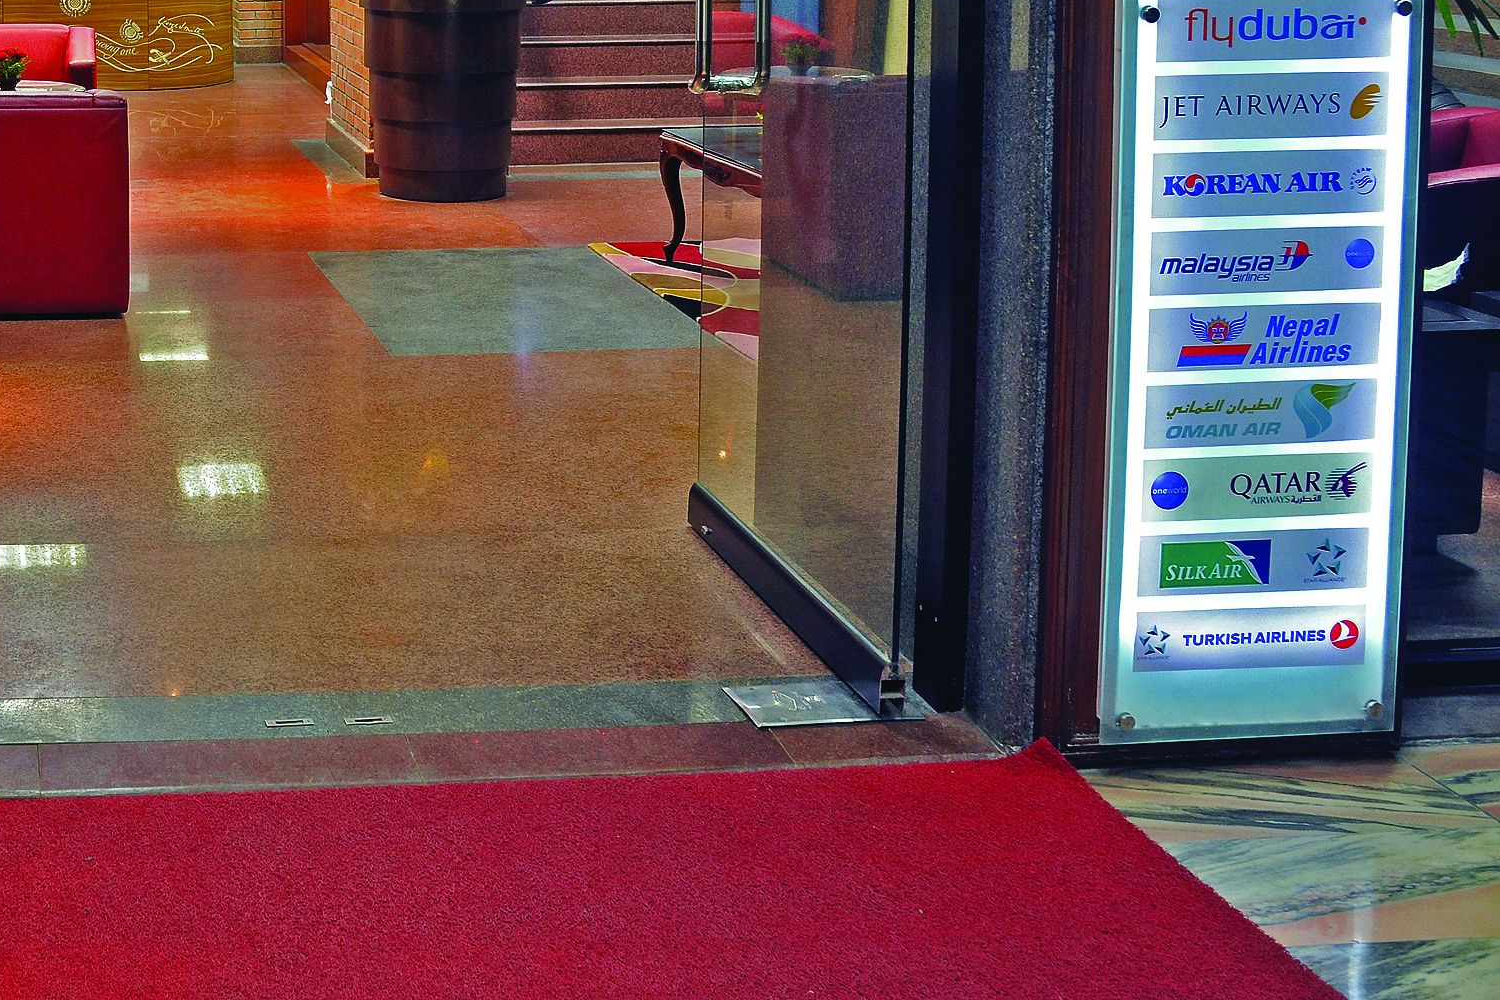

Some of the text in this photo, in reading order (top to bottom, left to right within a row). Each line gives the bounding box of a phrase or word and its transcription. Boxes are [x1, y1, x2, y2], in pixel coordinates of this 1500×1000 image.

[1184, 7, 1355, 48] flydubai
[1159, 92, 1341, 128] JET AIRWAYS
[1163, 171, 1343, 196] KOREAN AIR
[1159, 253, 1274, 279] malaysia
[1232, 273, 1270, 282] airlines
[1265, 313, 1340, 341] Nepal
[1250, 341, 1351, 364] Airlines
[1165, 422, 1281, 439] OMAN AIR
[1230, 471, 1321, 499] QATAR
[1251, 495, 1290, 505] AIRWAYS
[1183, 629, 1326, 647] TURKISH AIRLINES
